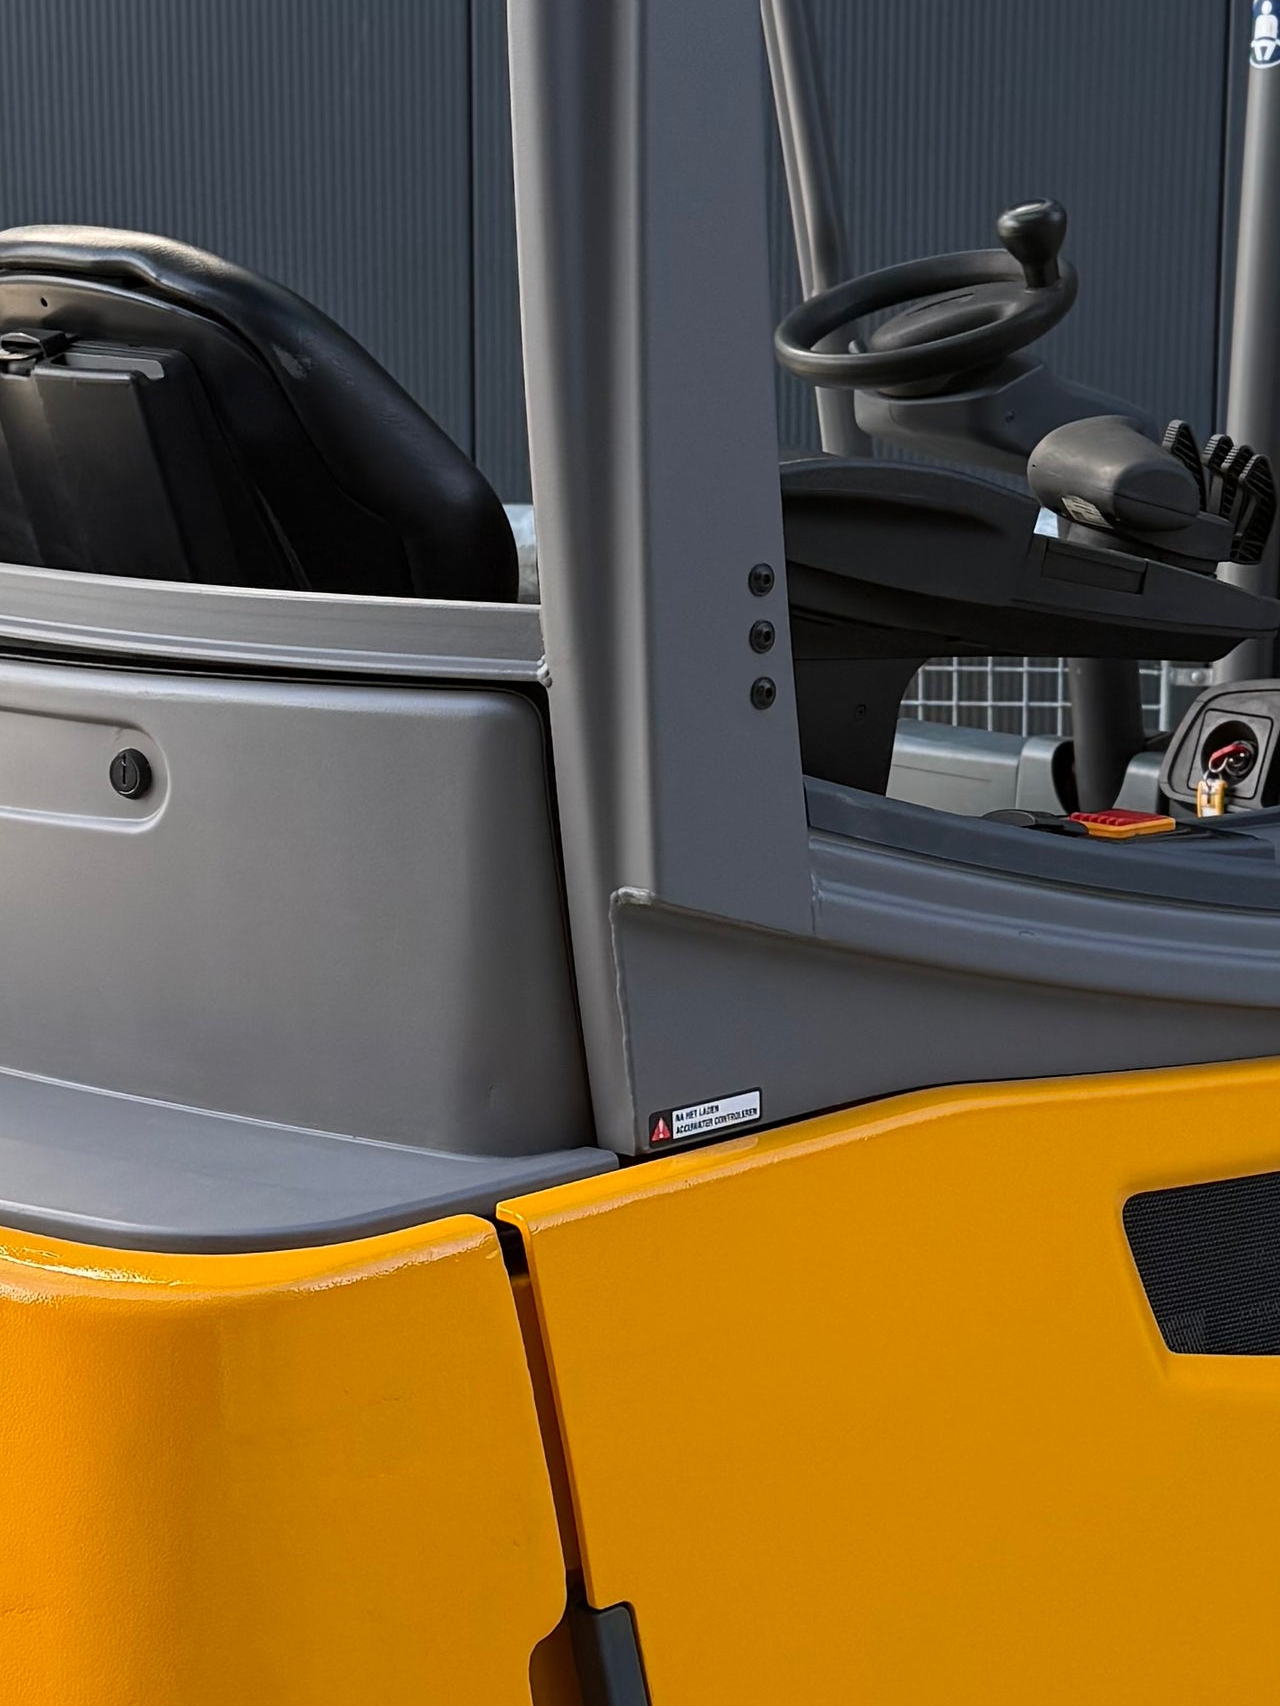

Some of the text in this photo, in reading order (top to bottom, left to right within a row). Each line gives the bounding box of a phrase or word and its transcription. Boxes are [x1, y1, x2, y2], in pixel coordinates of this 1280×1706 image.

[685, 1109, 698, 1120] HET
[699, 1104, 720, 1117] LADEN
[714, 1108, 757, 1125] CONTROLEREN
